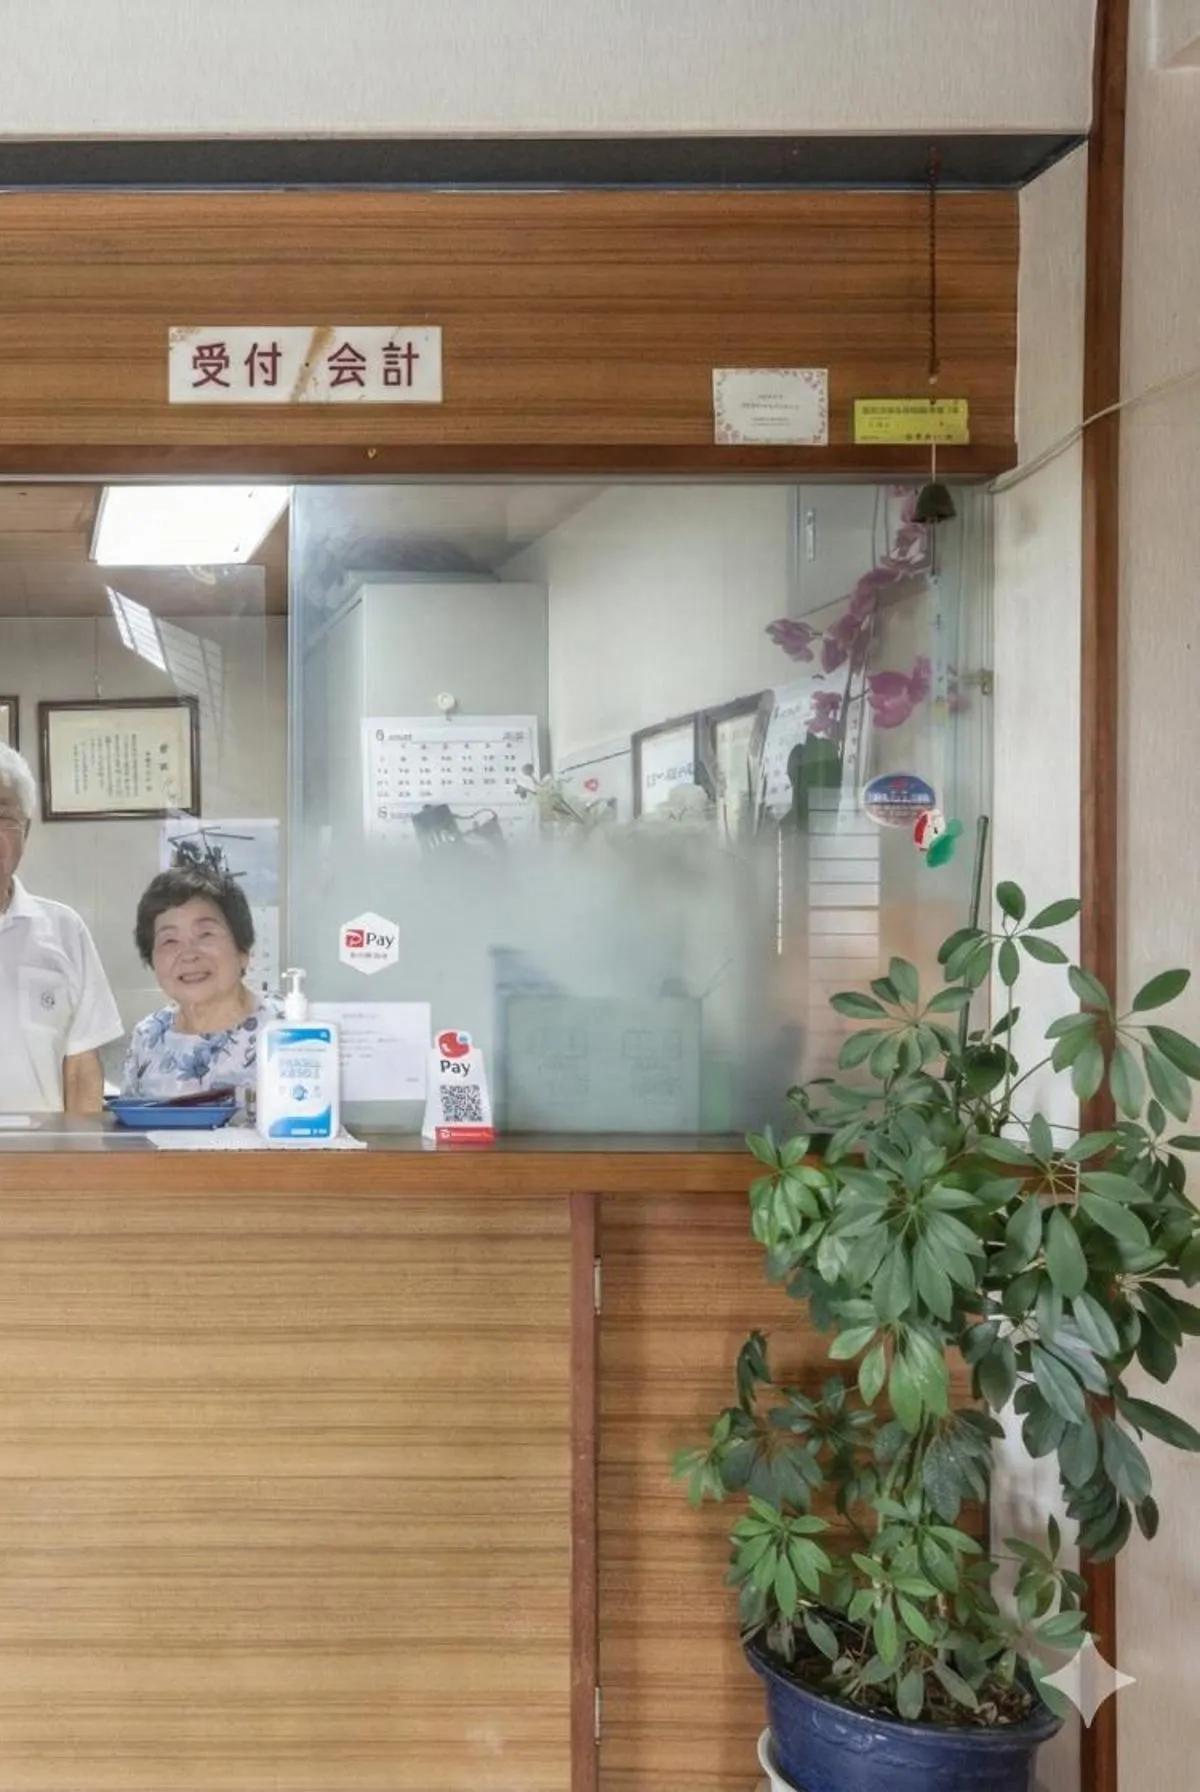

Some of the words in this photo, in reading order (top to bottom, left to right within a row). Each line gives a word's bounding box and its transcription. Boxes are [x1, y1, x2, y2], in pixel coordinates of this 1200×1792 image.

[191, 341, 283, 388] 受付
[327, 341, 420, 388] 会計
[440, 1060, 471, 1077] Pay
